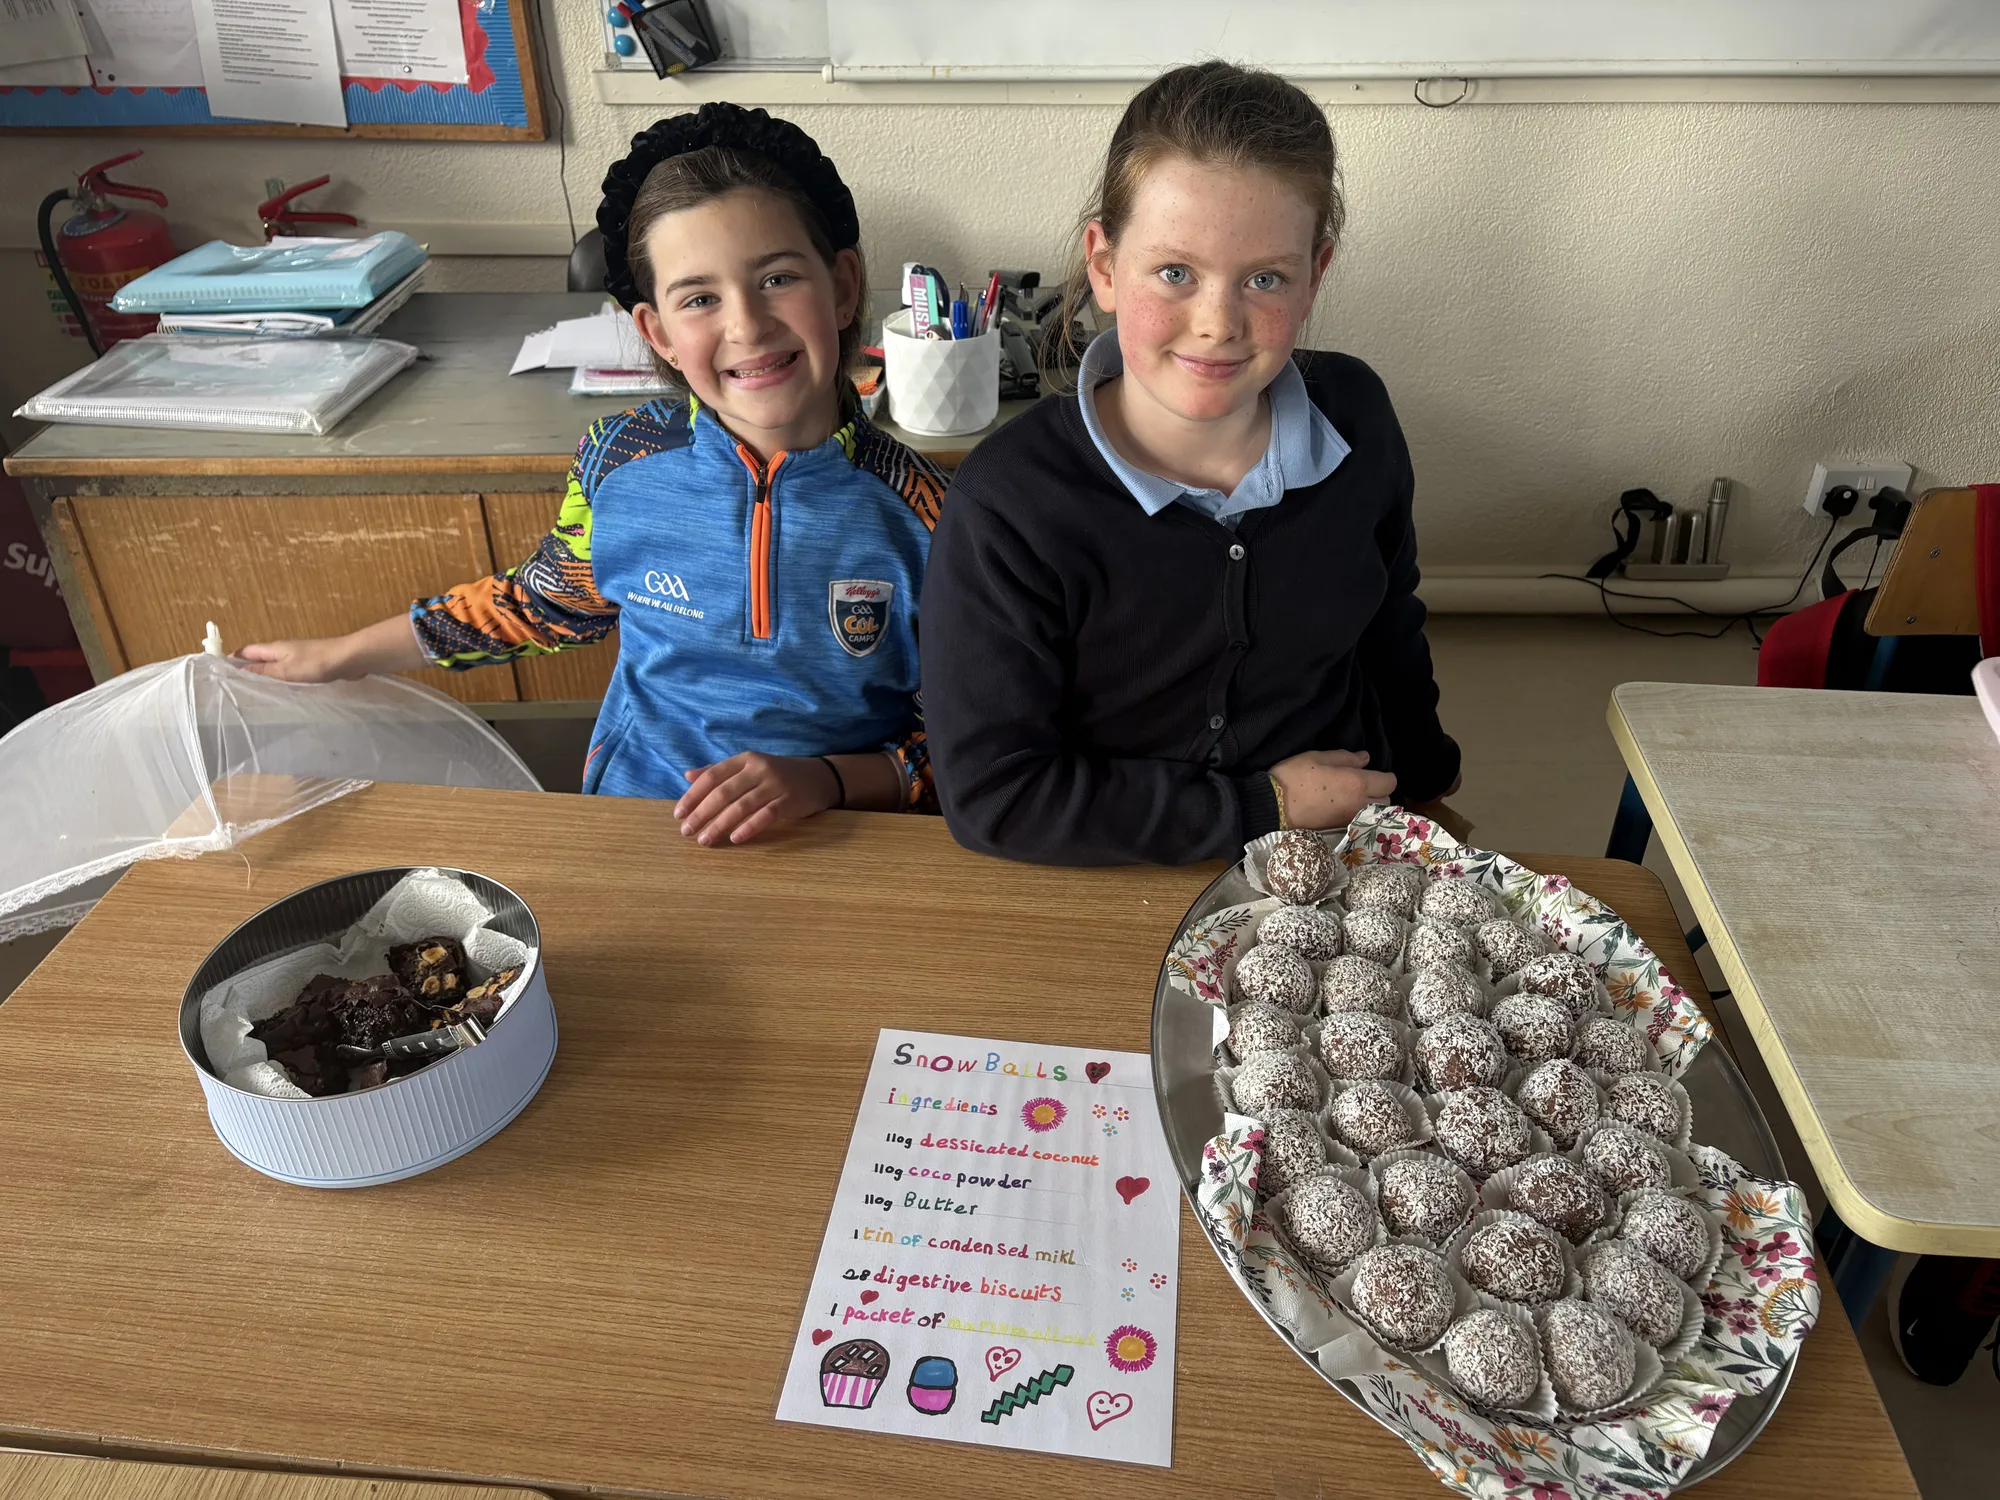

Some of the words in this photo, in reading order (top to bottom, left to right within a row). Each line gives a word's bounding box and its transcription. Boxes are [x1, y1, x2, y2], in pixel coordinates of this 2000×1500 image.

[3, 542, 63, 597] Su
[627, 591, 652, 606] WHERE
[651, 598, 662, 609] WE
[660, 601, 673, 612] ALL
[673, 605, 705, 620] BELONG
[845, 585, 881, 599] Kellogg's
[849, 634, 875, 643] CAMPS
[893, 1043, 978, 1073] Snow
[888, 1087, 998, 1116] ingredients
[886, 1133, 913, 1149] 110g
[920, 1133, 1029, 1157] dessicated
[1032, 1149, 1100, 1167] coconut
[874, 1163, 904, 1181] 110g
[908, 1166, 952, 1181] coco
[956, 1173, 1032, 1189] powder
[864, 1194, 893, 1212] 110g
[904, 1191, 979, 1216] Butter
[853, 1229, 859, 1240] 1
[863, 1227, 894, 1244] tin
[901, 1234, 923, 1247] of
[928, 1237, 1029, 1259] condensed
[1035, 1249, 1076, 1265] mikl
[842, 1269, 871, 1281] 28
[873, 1265, 973, 1292] digestive
[980, 1277, 1062, 1302] biscuits
[830, 1303, 838, 1317] 1
[842, 1305, 916, 1326] packet
[917, 1312, 946, 1329] of
